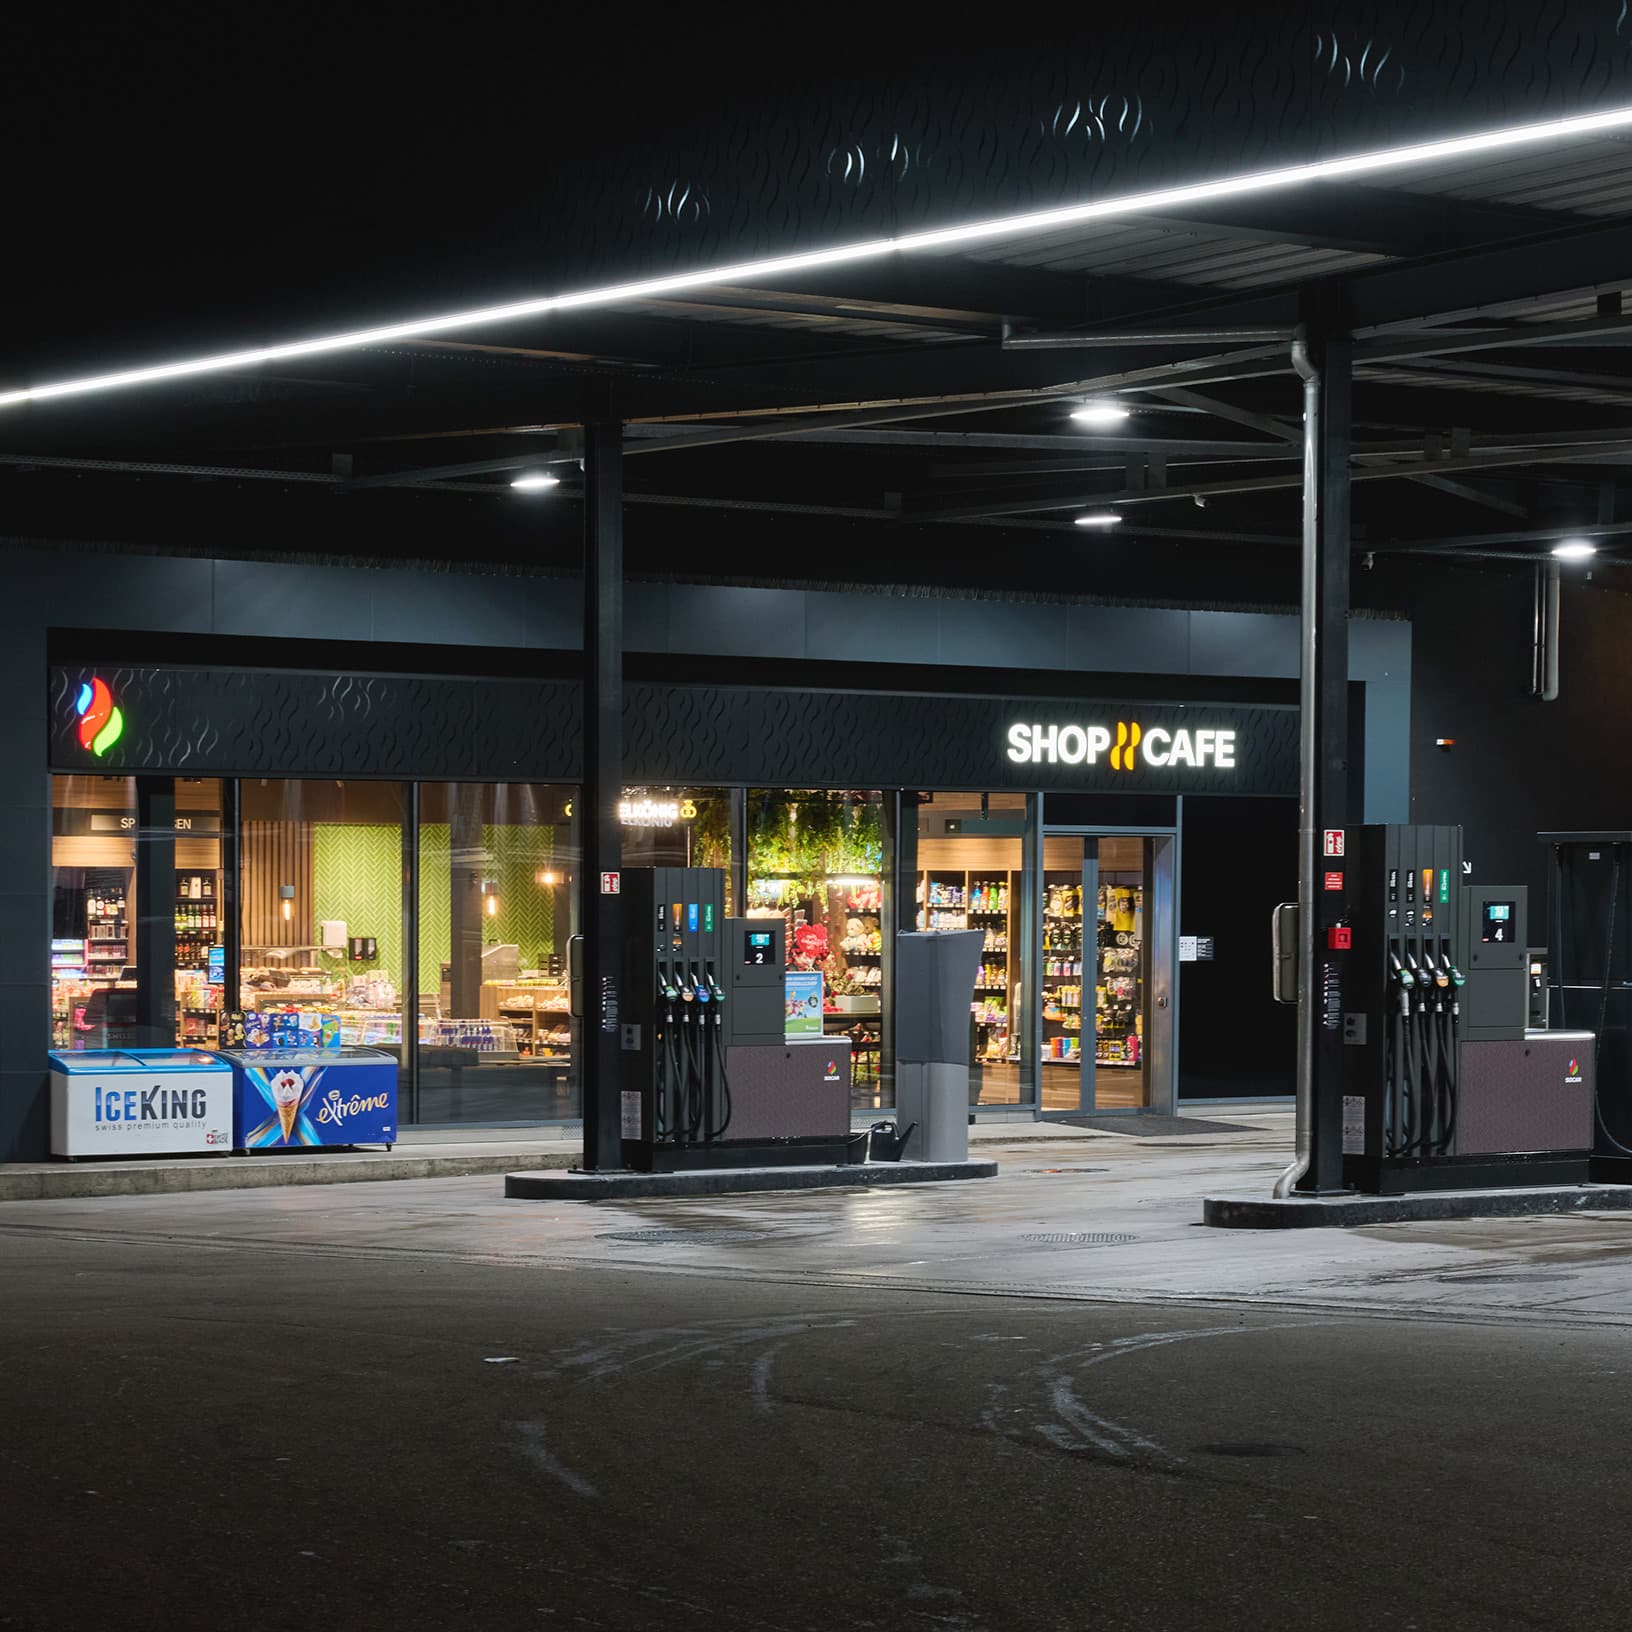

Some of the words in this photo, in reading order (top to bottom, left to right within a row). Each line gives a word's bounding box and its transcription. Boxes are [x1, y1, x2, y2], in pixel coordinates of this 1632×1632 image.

[1007, 724, 1110, 764] SHOP
[1142, 728, 1236, 767] CAFE
[618, 800, 678, 819] ELKÖNIG
[1495, 928, 1504, 942] 4
[755, 952, 764, 964] 2
[127, 1121, 169, 1131] premium
[173, 1120, 207, 1130] quality
